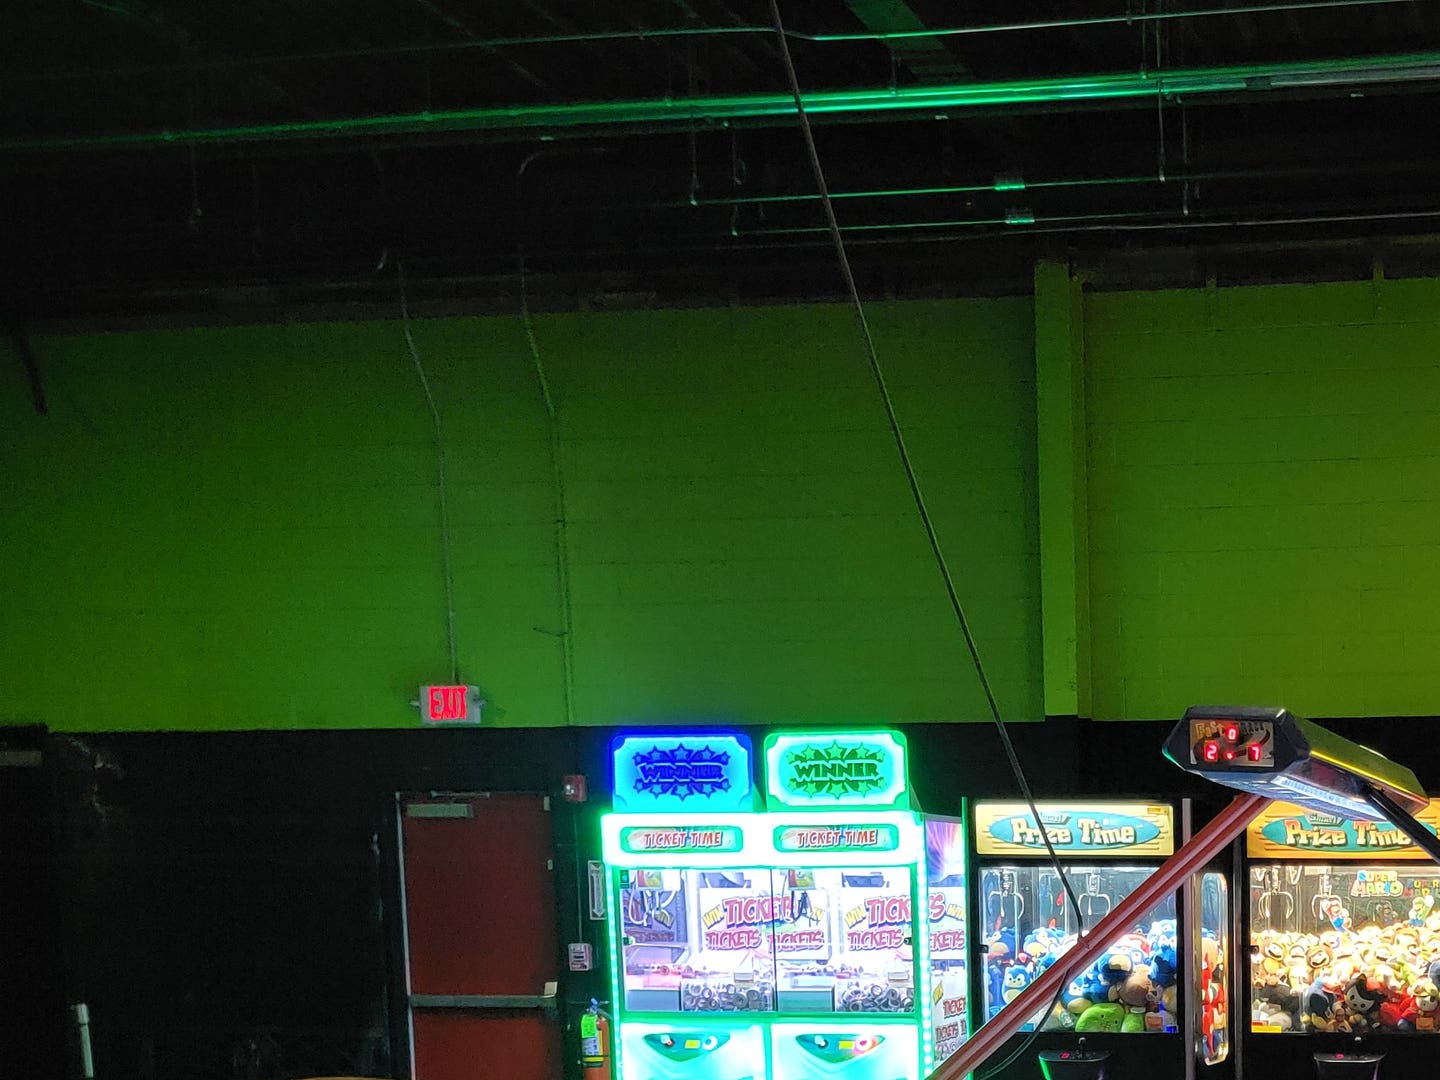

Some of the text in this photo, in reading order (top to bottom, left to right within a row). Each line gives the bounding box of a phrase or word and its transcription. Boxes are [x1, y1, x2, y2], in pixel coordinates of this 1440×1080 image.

[429, 686, 467, 720] EXIT
[640, 763, 724, 781] WINNER
[793, 762, 879, 781] WINNER
[643, 831, 724, 848] TICKET TIME
[797, 830, 878, 848] TICKET TIME
[1011, 818, 1135, 845] Prize Time
[1284, 820, 1411, 847] Prize Time
[706, 929, 762, 950] TICKETS
[847, 929, 903, 950] TICKETS
